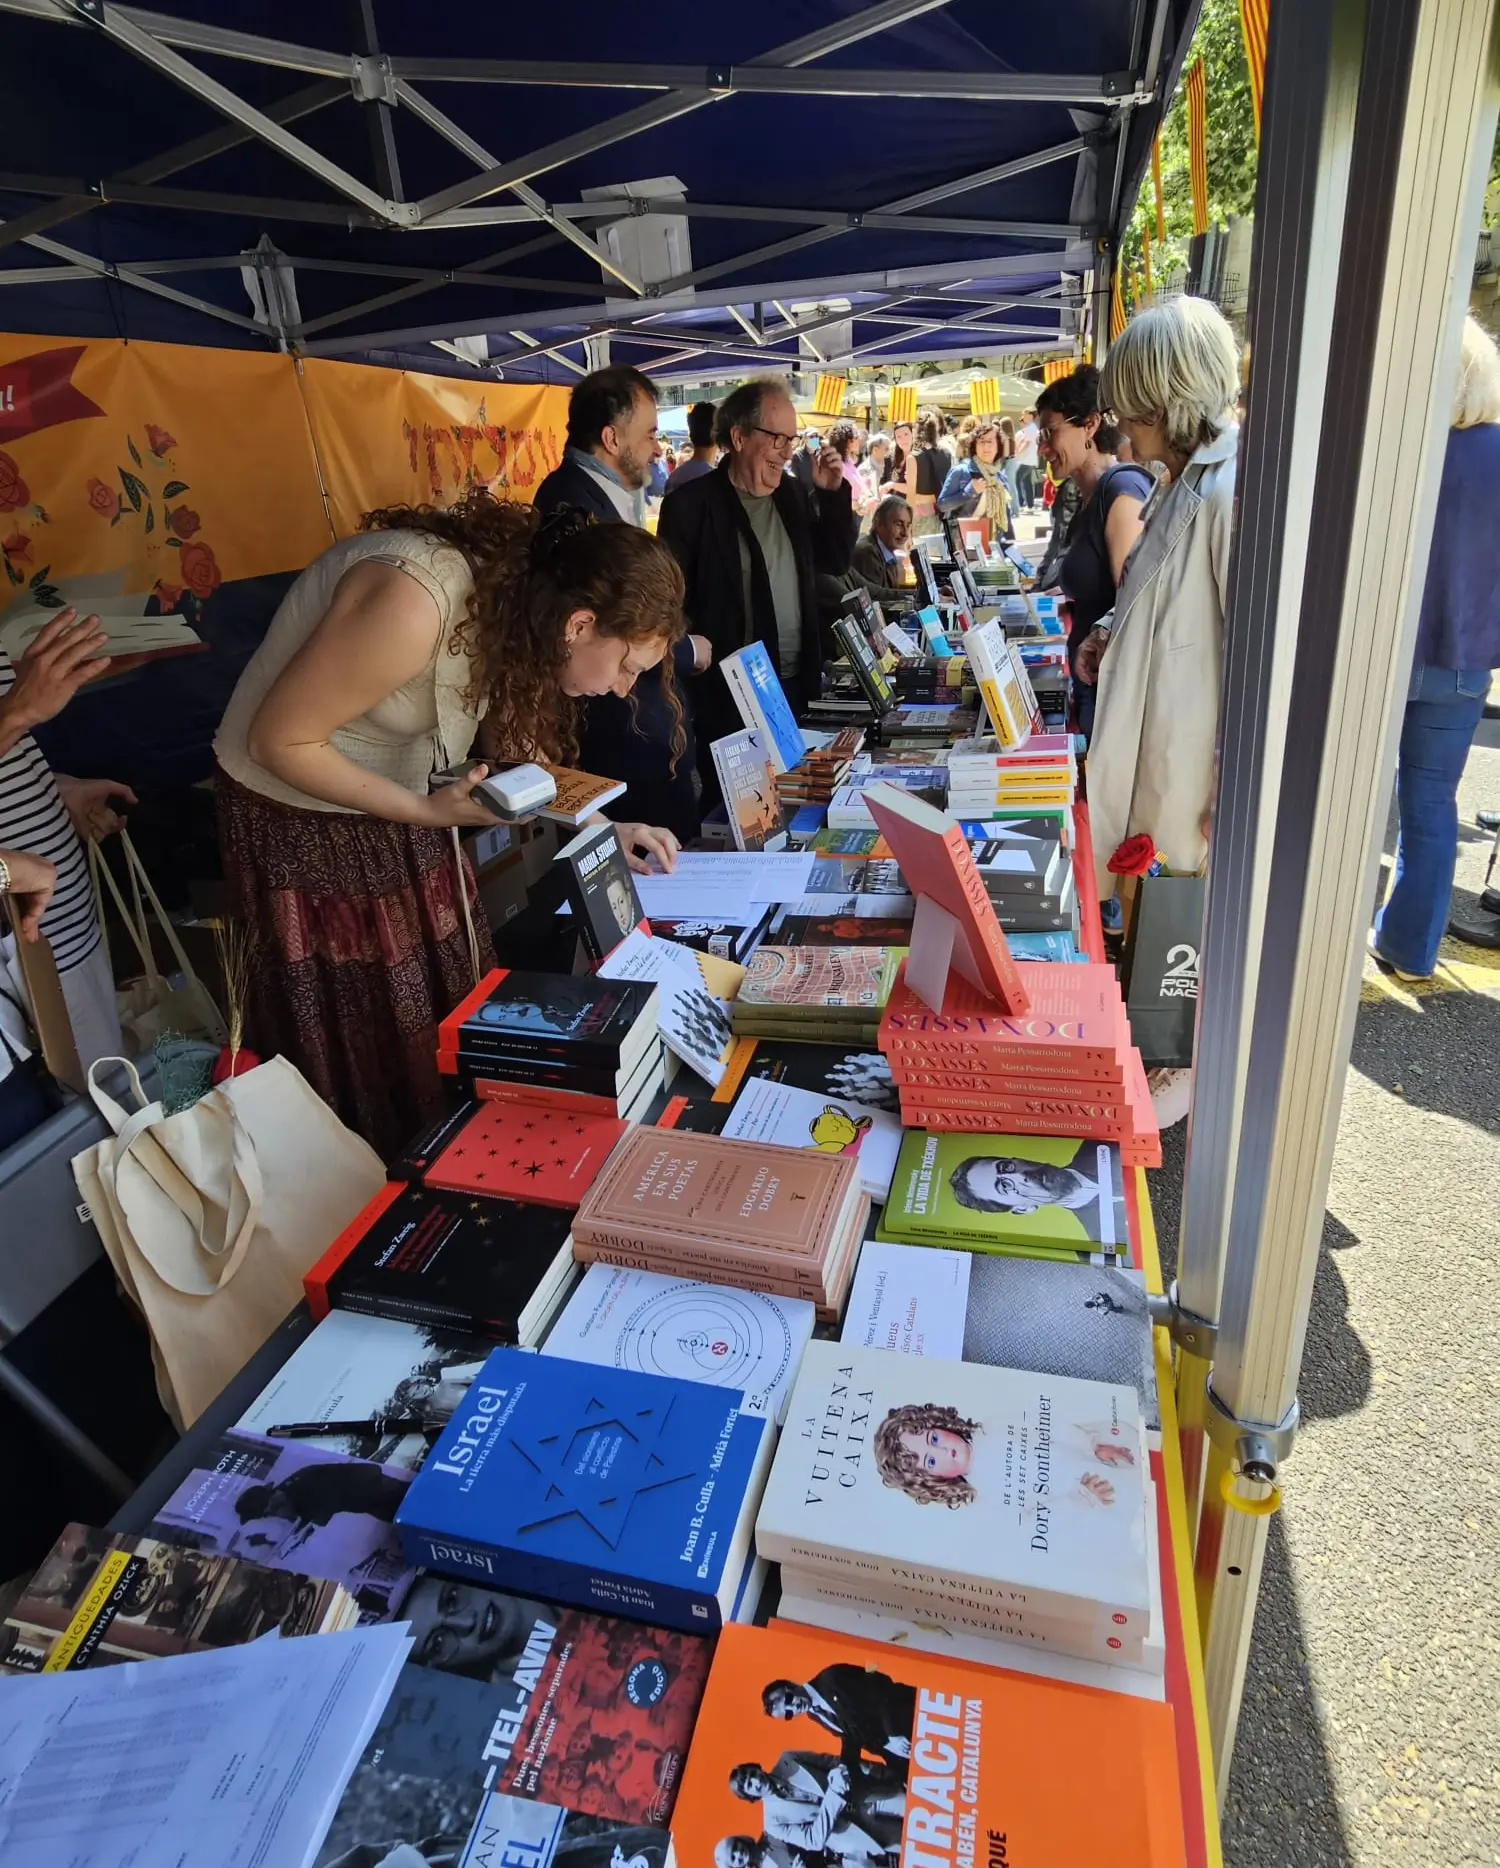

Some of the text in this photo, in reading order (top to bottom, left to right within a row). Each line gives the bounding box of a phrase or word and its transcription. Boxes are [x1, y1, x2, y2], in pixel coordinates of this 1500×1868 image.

[578, 851, 600, 878] MARIA
[596, 836, 618, 863] STUART
[1164, 943, 1200, 977] 2
[1160, 988, 1198, 998] NAC
[1161, 978, 1199, 989] POL
[888, 1014, 1085, 1040] DONASSES
[892, 1037, 1071, 1059] DONASSES Marta Pessarrodona
[900, 1055, 1079, 1076] DONASSES Marta Pessarrodona
[904, 1073, 1082, 1096] DONASSES Marta Pessarrodona
[916, 1112, 1092, 1131] DONASSES Marta Pessarrodona
[1025, 1101, 1117, 1118] DONASSES
[633, 1150, 669, 1201] AMÉRICA
[652, 1158, 682, 1197] EN SUS
[669, 1160, 698, 1201] POETAS
[919, 1170, 931, 1181] DE
[739, 1167, 769, 1218] EDGARDO
[759, 1176, 781, 1212] DOBRY
[915, 1182, 929, 1202] VIDA
[914, 1203, 926, 1214] LA
[374, 1222, 417, 1267] Stefan Zweig
[590, 1231, 645, 1251] DOBRY
[595, 1251, 648, 1270] DOBRY
[905, 1297, 918, 1333] Catalans
[319, 1394, 345, 1424] ántula
[432, 1385, 508, 1477] Israel
[460, 1382, 527, 1492] La tierra más disputada
[801, 1417, 816, 1438] LA
[805, 1365, 853, 1506] VUITENA
[839, 1390, 874, 1487] CAIXA
[581, 1430, 600, 1463] sionismo
[593, 1436, 610, 1467] conflicto
[605, 1436, 623, 1469] Palestina
[709, 1439, 729, 1473] Adrià
[1004, 1424, 1014, 1505] DE L'AUTORA DE
[1031, 1395, 1051, 1553] Dory Sontheimer
[185, 1450, 237, 1511] JOSEPH ROTH
[695, 1481, 715, 1514] Culla
[1018, 1492, 1026, 1508] LES
[688, 1514, 704, 1530] B.
[429, 1543, 494, 1575] Israel
[680, 1530, 698, 1563] Joan
[791, 1547, 852, 1565] SONTHEIMER
[855, 1561, 880, 1571] DORY
[891, 1568, 935, 1585] CAIXA
[591, 1587, 619, 1603] Culla
[633, 1594, 655, 1609] Joan
[816, 1587, 876, 1605] SONTHEIMER
[940, 1577, 1004, 1598] VUITENA
[1009, 1592, 1026, 1602] LA
[52, 1559, 123, 1671] ANTIGÜEDADES
[76, 1562, 140, 1664] CYNTHIA OZICK
[914, 1607, 957, 1623] CAIXA
[960, 1617, 1025, 1635] VUITENA
[1006, 1610, 1023, 1620] LA
[627, 1662, 665, 1705] SEGONA EDICIÓ
[512, 1641, 573, 1788] Dues bessones separades
[526, 1717, 557, 1792] pel nazisme
[959, 1699, 984, 1804] CATALUNYA
